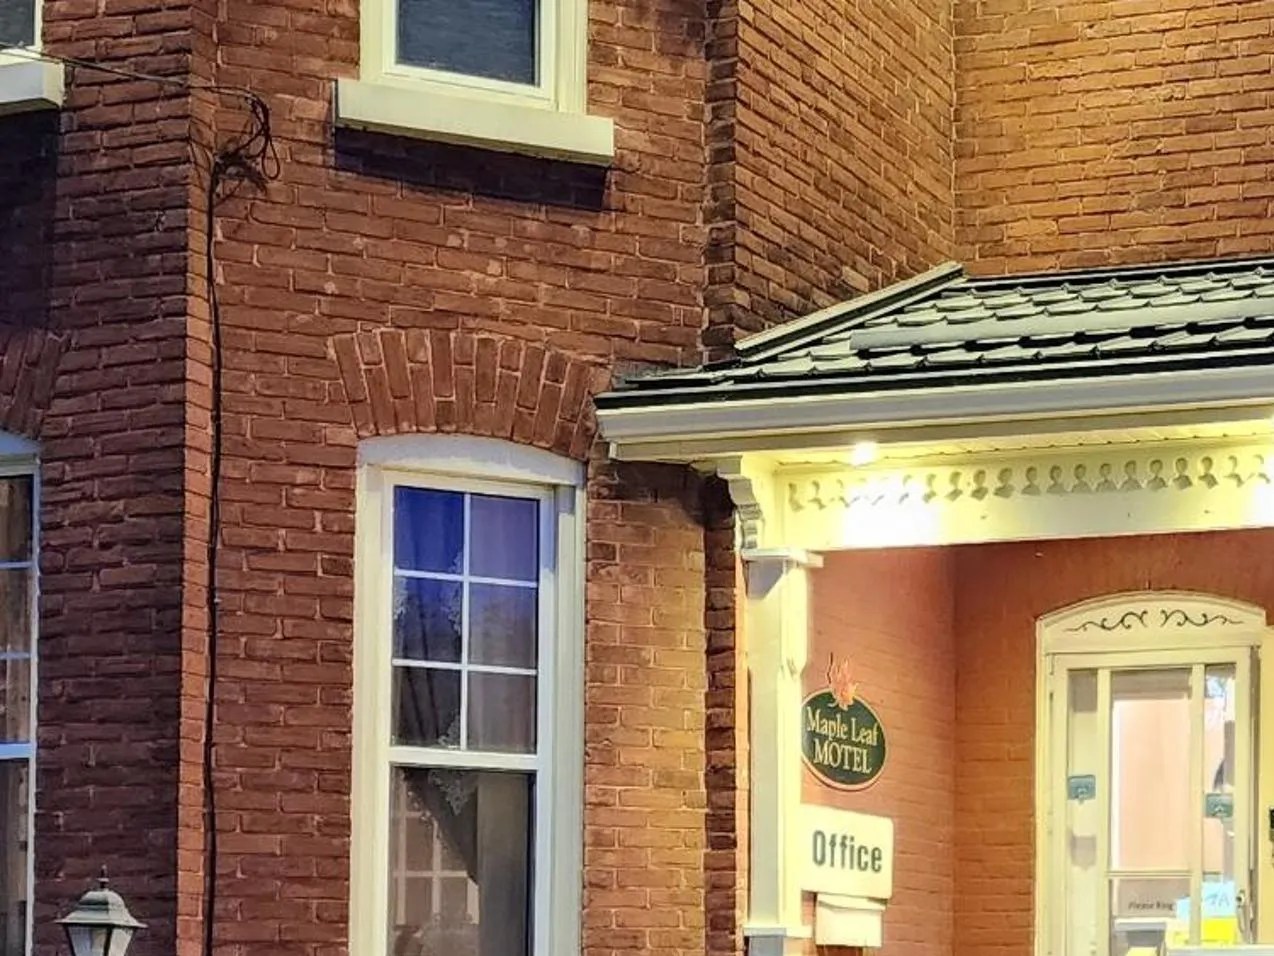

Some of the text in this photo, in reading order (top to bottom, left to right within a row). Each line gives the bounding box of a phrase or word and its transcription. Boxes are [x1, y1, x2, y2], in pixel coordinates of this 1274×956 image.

[806, 706, 879, 746] Maple Leaf
[813, 739, 873, 774] MOTEL
[813, 830, 882, 872] Office
